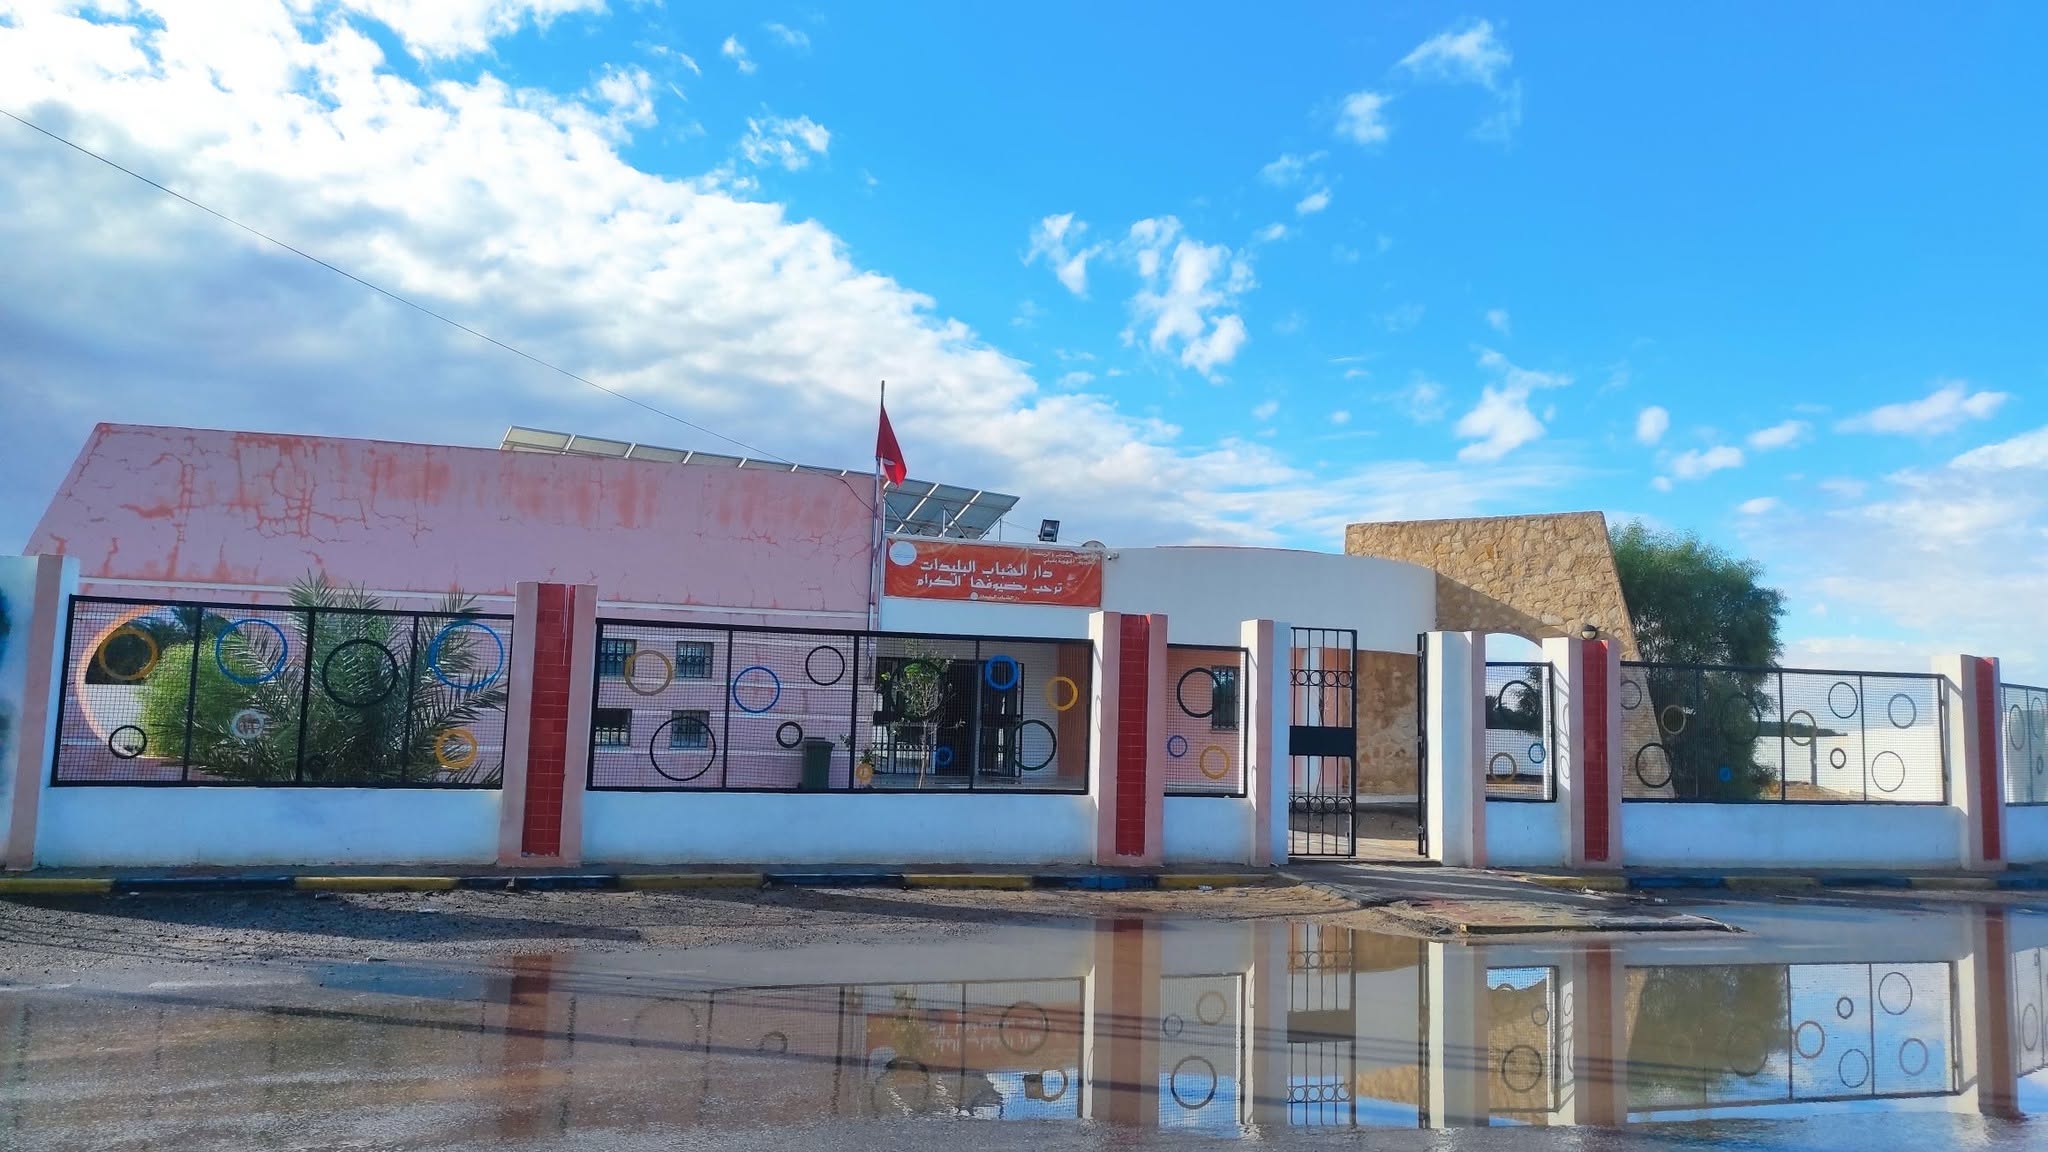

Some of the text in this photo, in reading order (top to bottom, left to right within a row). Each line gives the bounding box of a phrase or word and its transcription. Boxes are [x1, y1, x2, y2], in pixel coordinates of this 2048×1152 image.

[982, 561, 1028, 579] الشباب
[1033, 564, 1053, 580] دار
[916, 573, 1063, 595] ترحب بضيوفها الكرام
